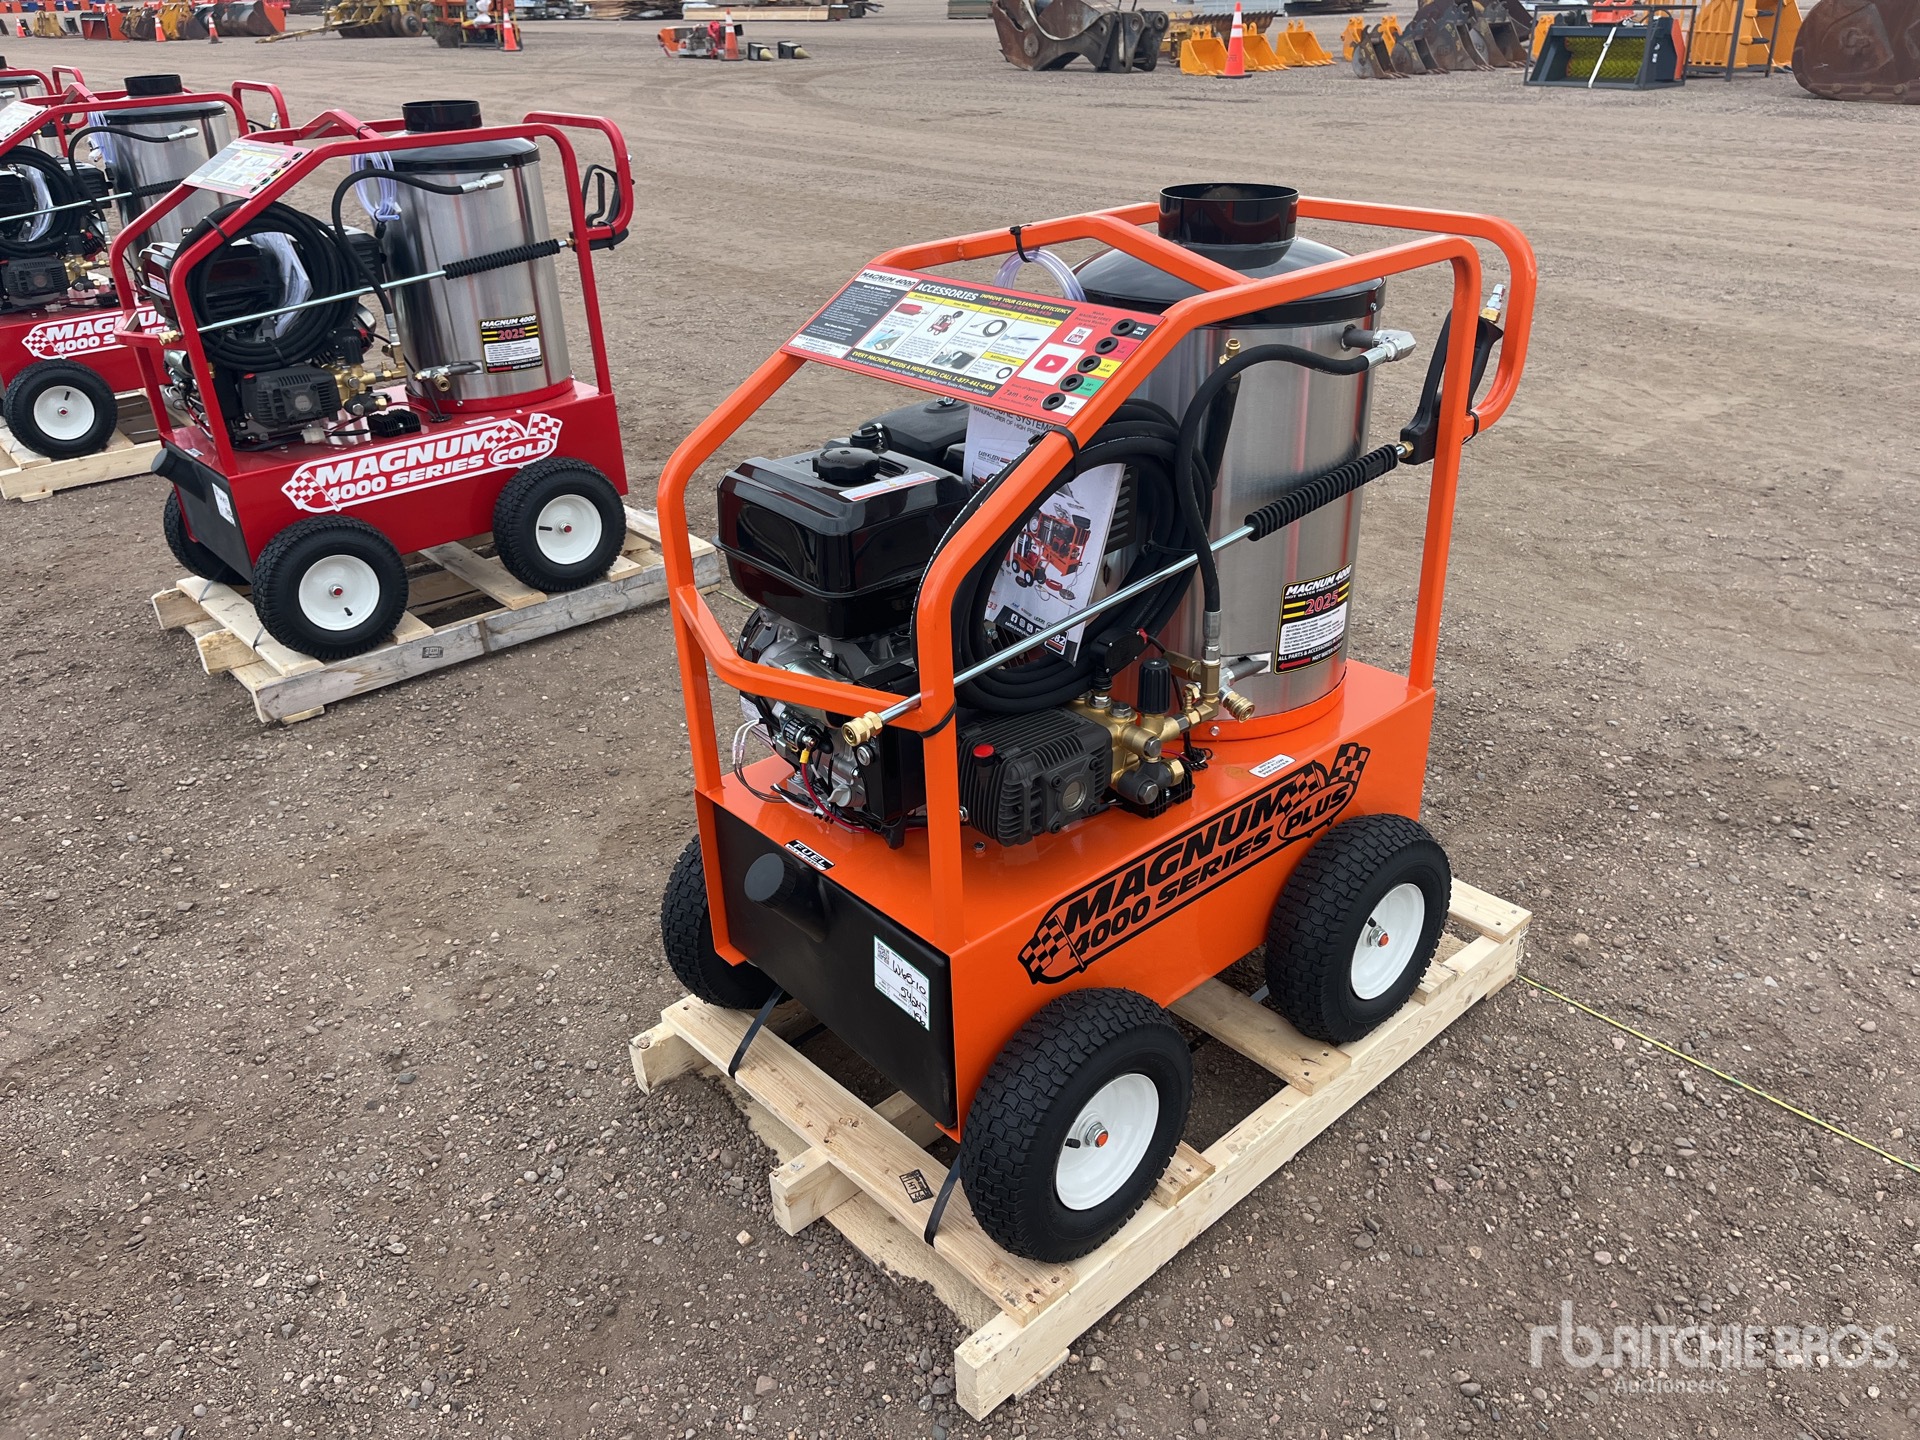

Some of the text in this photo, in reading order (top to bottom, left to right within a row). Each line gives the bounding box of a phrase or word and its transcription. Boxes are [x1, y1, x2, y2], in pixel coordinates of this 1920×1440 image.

[860, 272, 896, 282] MAGNUM
[915, 283, 979, 301] ACCESSORIES
[980, 293, 1003, 302] IMPROVE
[1016, 300, 1042, 309] CLEANING
[1040, 305, 1072, 315] EFFICIENCY
[482, 318, 518, 327] MAGNUM
[519, 314, 536, 324] 4000
[498, 328, 526, 340] 2025
[54, 335, 101, 353] 4000
[866, 355, 890, 364] MACHINE
[890, 360, 907, 368] NEEDS
[1004, 389, 1018, 397] 7am
[1022, 394, 1038, 403] 4pm
[973, 406, 1006, 423] MANUFACTURER
[1014, 423, 1026, 431] HIGH
[1016, 413, 1052, 431] SYSTEM
[314, 430, 495, 487] MAGNUM
[325, 440, 550, 503] 4000 SERIES GOLD
[1285, 573, 1336, 596] MAGNUM
[1298, 590, 1316, 598] WATER
[1305, 589, 1340, 616] 2025
[1288, 652, 1303, 660] PARTS
[793, 841, 828, 867] FUEL
[1063, 779, 1295, 934] MAGNUM
[1070, 783, 1350, 957] 4000 SERIES PLUS
